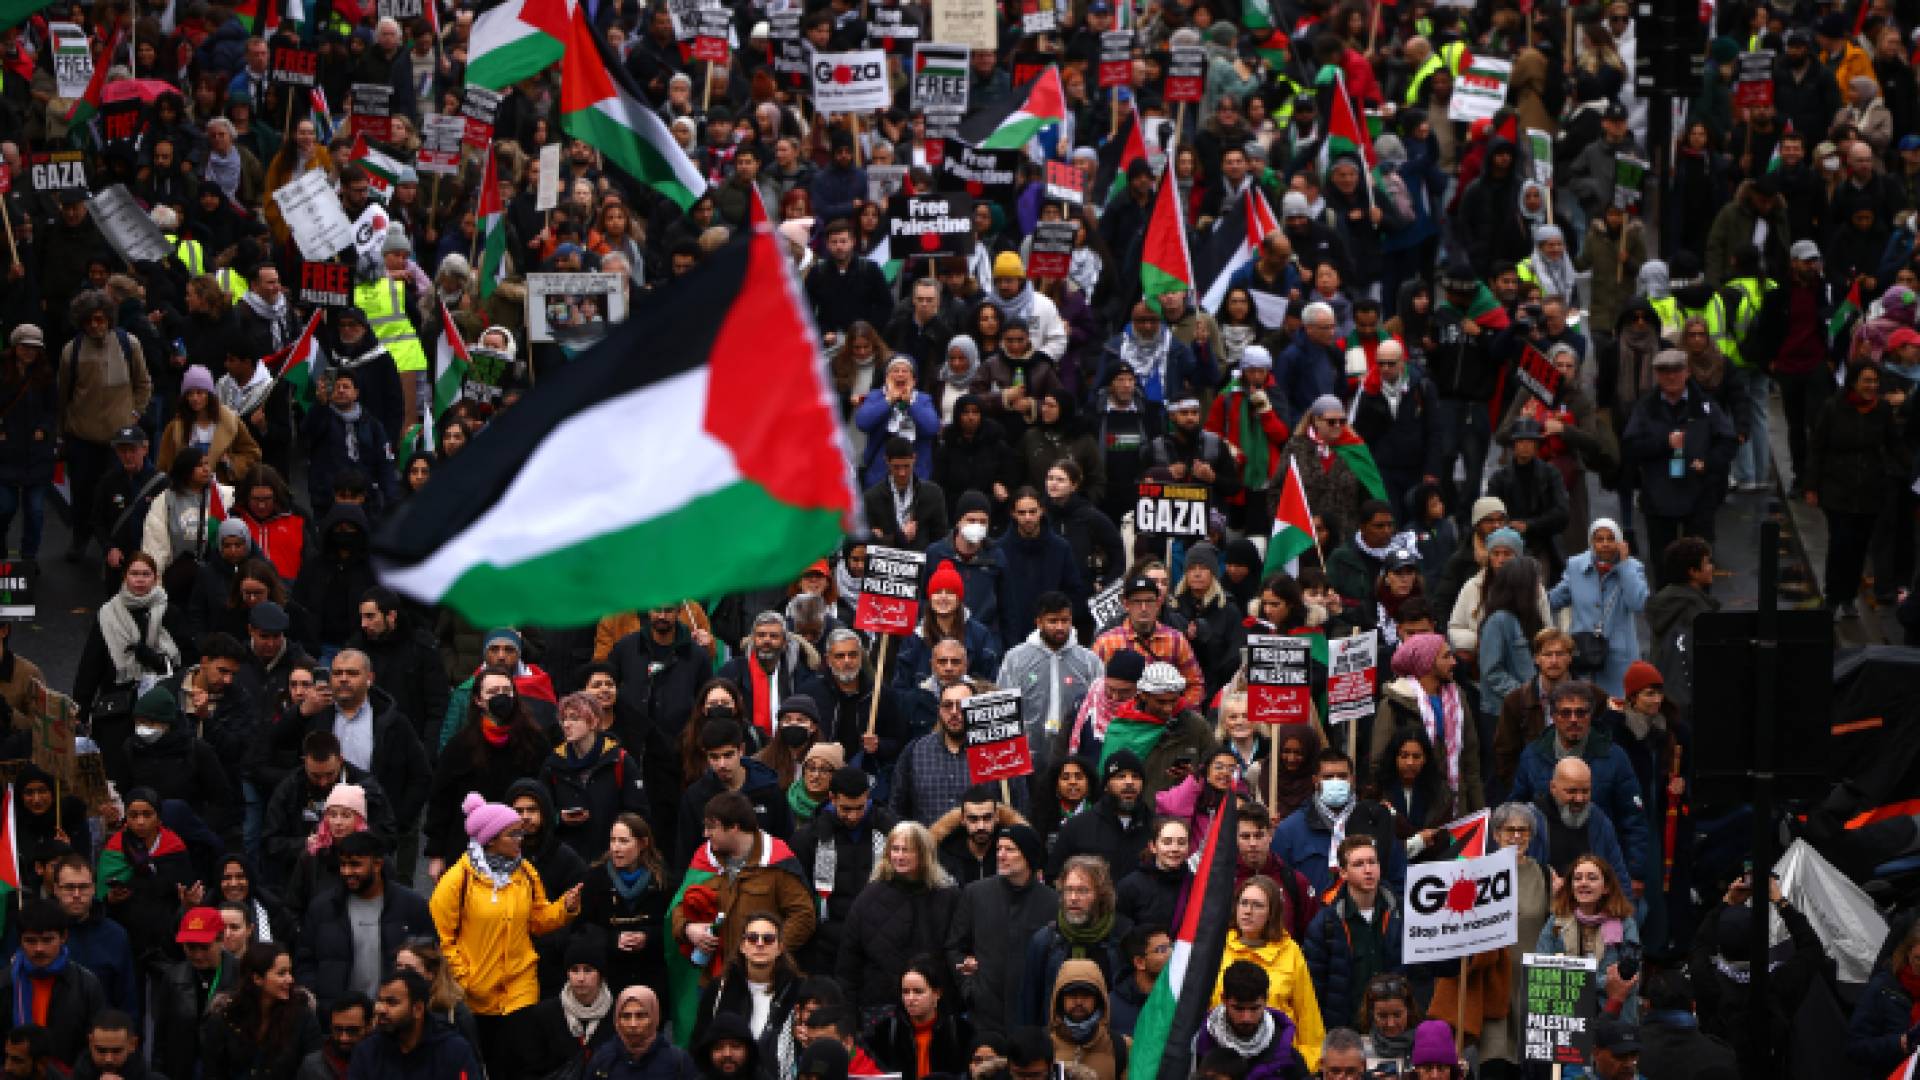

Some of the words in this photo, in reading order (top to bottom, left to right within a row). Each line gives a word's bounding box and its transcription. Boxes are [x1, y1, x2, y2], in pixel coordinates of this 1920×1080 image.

[815, 61, 881, 84] Gza
[915, 76, 968, 96] FREE
[962, 148, 997, 169] Free
[32, 161, 88, 190] GAZA
[944, 156, 1013, 184] Palestine
[909, 199, 949, 217] Free
[891, 215, 971, 235] Palestine
[302, 261, 349, 295] FREE
[1137, 497, 1208, 535] GAZA
[869, 558, 919, 578] FREEDOM
[864, 577, 919, 599] PALESTINE
[1252, 647, 1305, 664] FREEDOM
[1250, 667, 1308, 684] PALESTINE
[966, 701, 1017, 725] FREEDOM
[1409, 868, 1512, 916] Gza
[1409, 925, 1439, 940] Stop
[1441, 922, 1460, 935] the
[1527, 968, 1562, 985] FROM
[1565, 971, 1586, 987] THE
[1527, 983, 1562, 1000] RIVER
[1565, 985, 1581, 1002] TO
[1527, 998, 1549, 1014] THE
[1552, 1000, 1575, 1016] SEA
[1526, 1012, 1586, 1033] PALESTINE
[1525, 1029, 1552, 1044] WILL
[1557, 1031, 1572, 1047] BE
[1525, 1044, 1554, 1061] FREE
